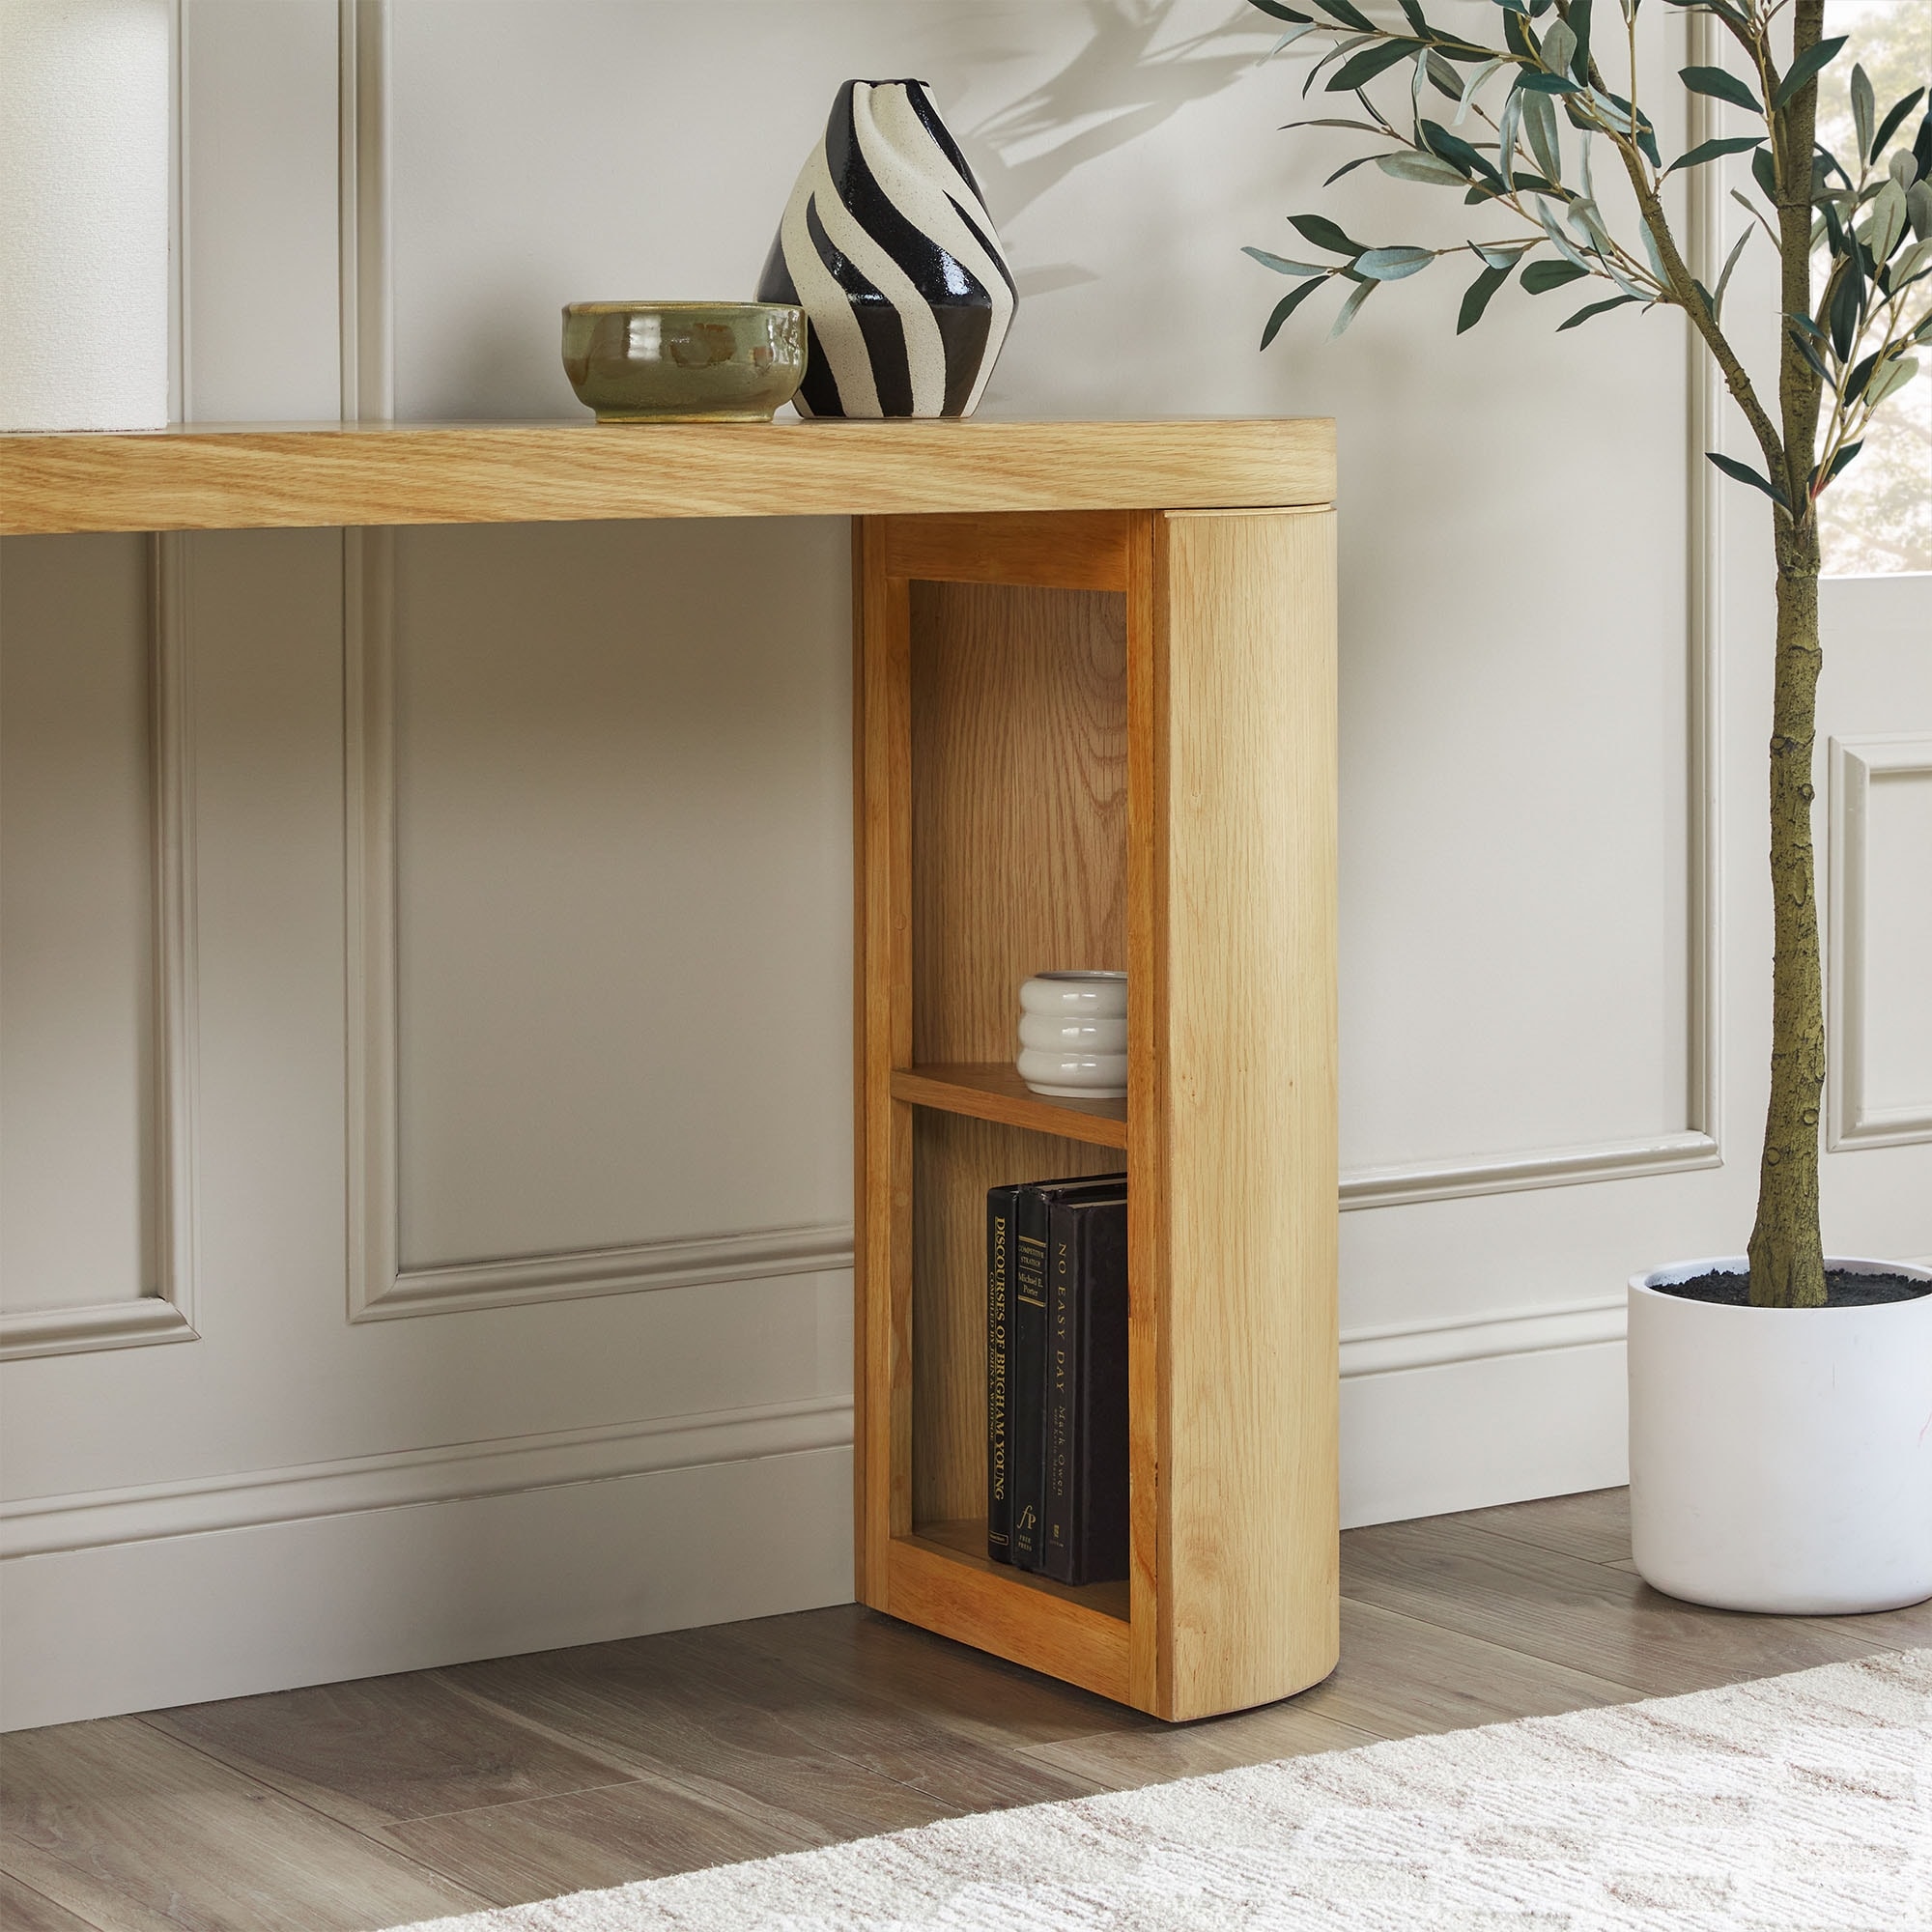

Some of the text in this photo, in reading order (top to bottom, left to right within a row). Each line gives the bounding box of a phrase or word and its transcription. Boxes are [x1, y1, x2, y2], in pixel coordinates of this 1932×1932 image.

[1018, 1271, 1044, 1288] Michael E.
[1023, 1284, 1038, 1296] Porter
[1056, 1242, 1067, 1393] NO EASY DAY
[988, 1331, 995, 1345] BY
[995, 1217, 1006, 1500] DISCOURSES OF BRIGHAM YOUNG
[1057, 1454, 1065, 1496] Owen
